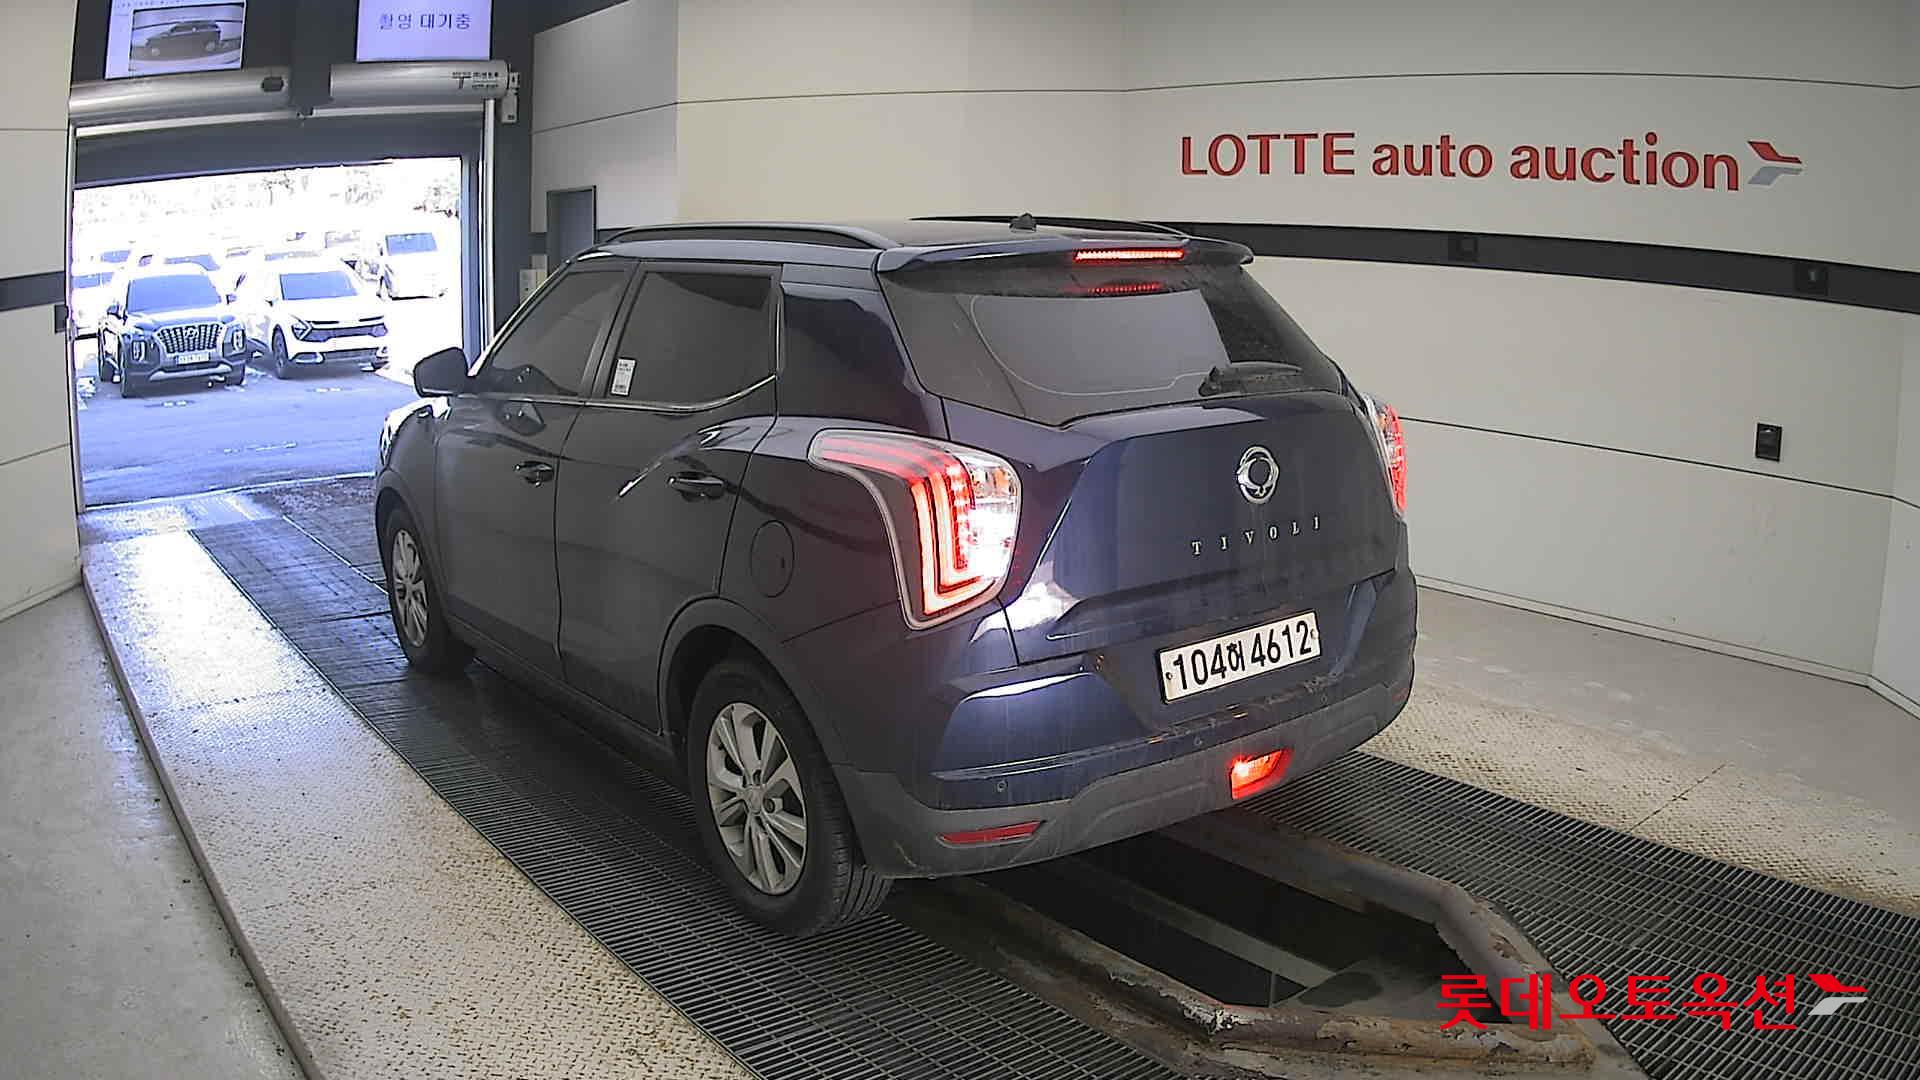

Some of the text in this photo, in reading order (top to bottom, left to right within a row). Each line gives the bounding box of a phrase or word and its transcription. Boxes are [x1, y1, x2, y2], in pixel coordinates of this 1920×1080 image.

[1181, 131, 1740, 192] LOTTE auto auction
[1191, 516, 1321, 556] TIVOLI
